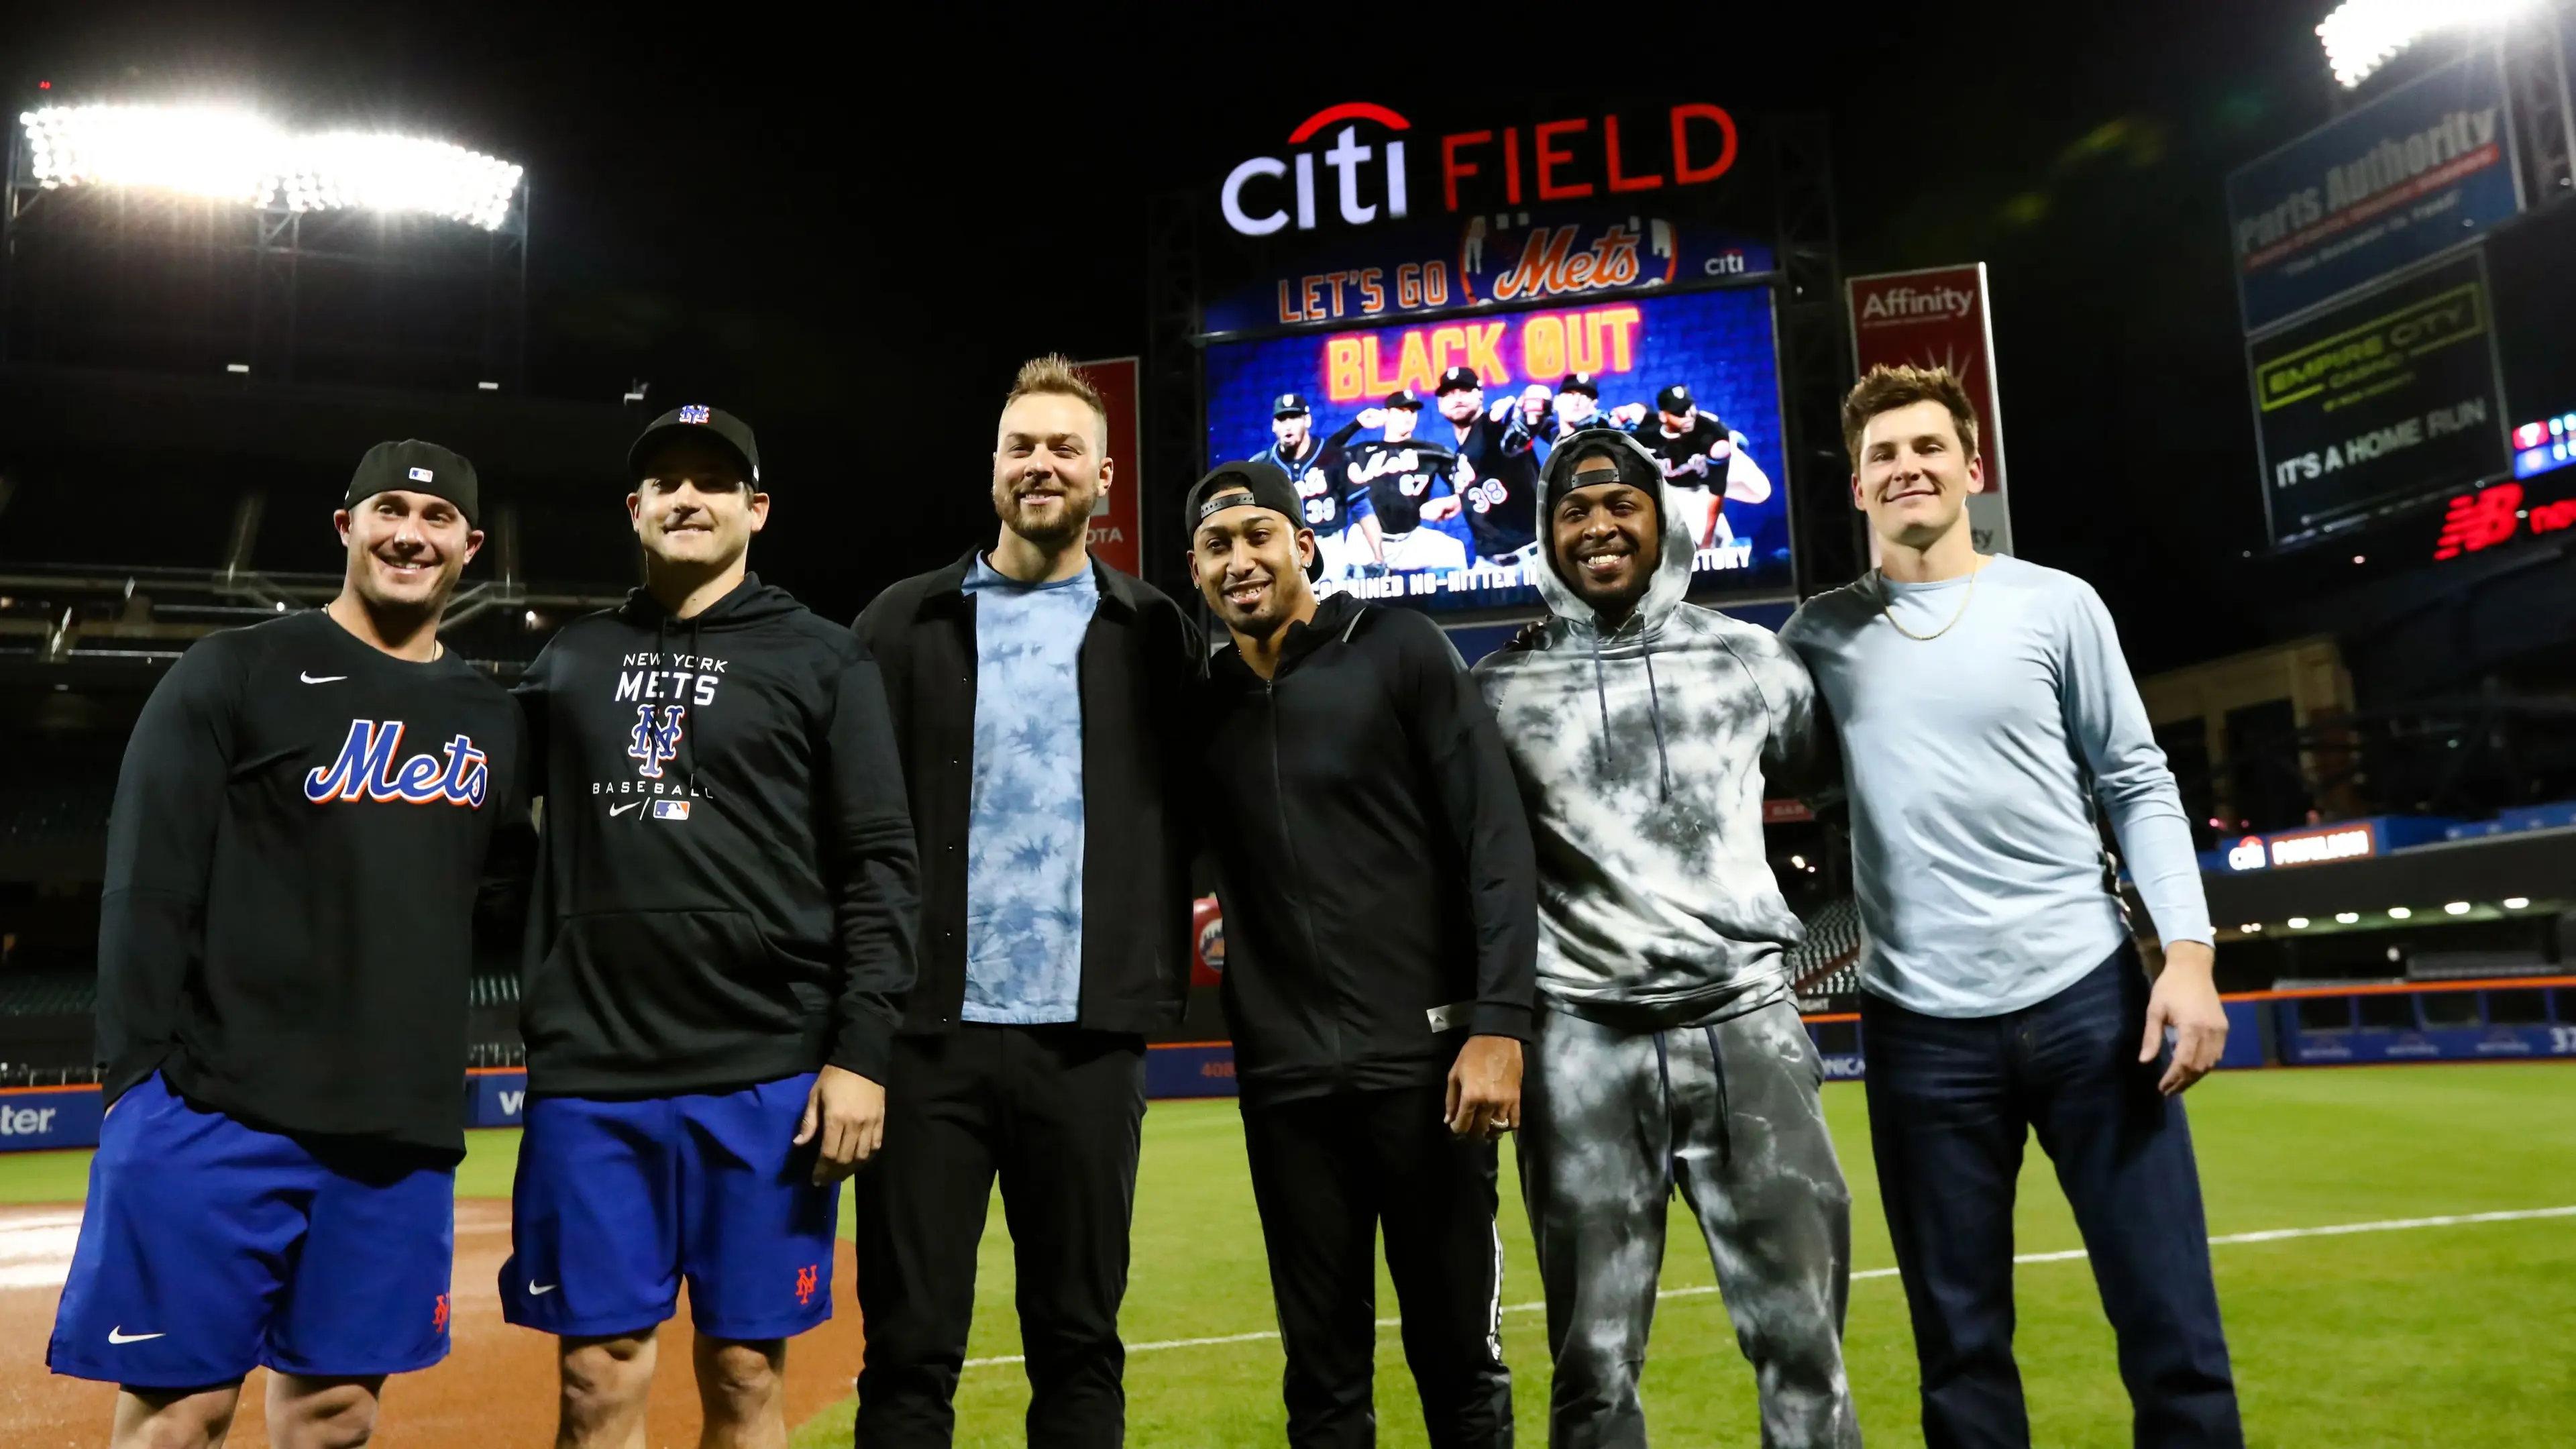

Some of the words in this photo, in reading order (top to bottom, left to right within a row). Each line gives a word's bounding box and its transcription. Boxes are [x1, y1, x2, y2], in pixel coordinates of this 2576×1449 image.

[1442, 103, 1738, 212] FIELD
[1493, 224, 1642, 301] Mets
[1279, 266, 1385, 323] LET'S
[1397, 260, 1448, 309] GO
[1862, 286, 1974, 321] Affinity
[1327, 321, 1512, 402] BLACK
[2324, 445, 2345, 474] A
[1468, 478, 1509, 513] 38
[623, 652, 665, 667] NEW
[673, 653, 729, 673] YORK
[614, 670, 719, 706] METS
[304, 718, 488, 810] Mets
[592, 780, 713, 799] BASEBALL
